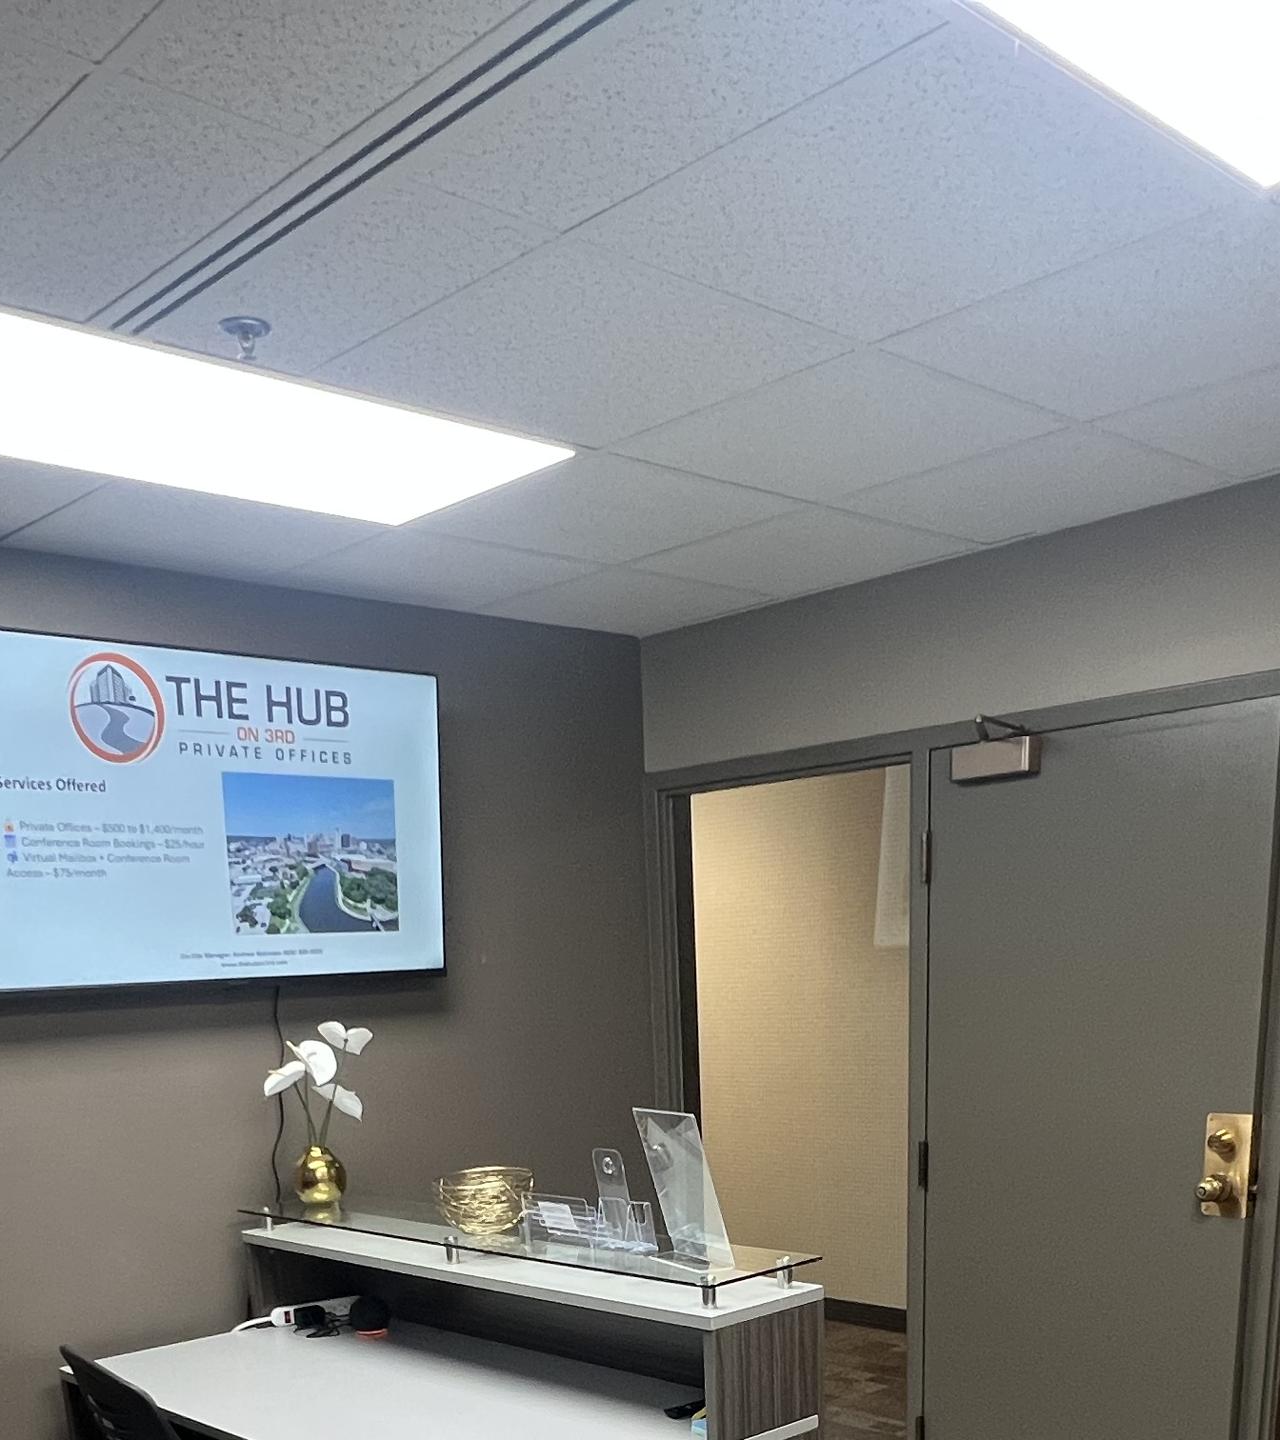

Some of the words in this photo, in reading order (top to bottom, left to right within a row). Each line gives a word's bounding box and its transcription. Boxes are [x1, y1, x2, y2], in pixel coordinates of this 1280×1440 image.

[165, 675, 250, 721] THE
[266, 684, 350, 728] HUB
[236, 726, 259, 742] ON
[265, 728, 296, 744] 3RD
[179, 742, 263, 760] PRIVATE
[275, 748, 352, 765] OFFICES
[55, 778, 106, 792] Offered
[19, 820, 55, 832] Private
[57, 822, 93, 832] Offices
[21, 837, 81, 847] Conference
[82, 837, 111, 847] Room
[113, 838, 156, 850] Bookings
[22, 852, 56, 862] Virtual
[58, 853, 97, 863] Mailbox
[106, 853, 162, 863] Conference
[163, 853, 190, 863] Room
[6, 867, 44, 878] Access
